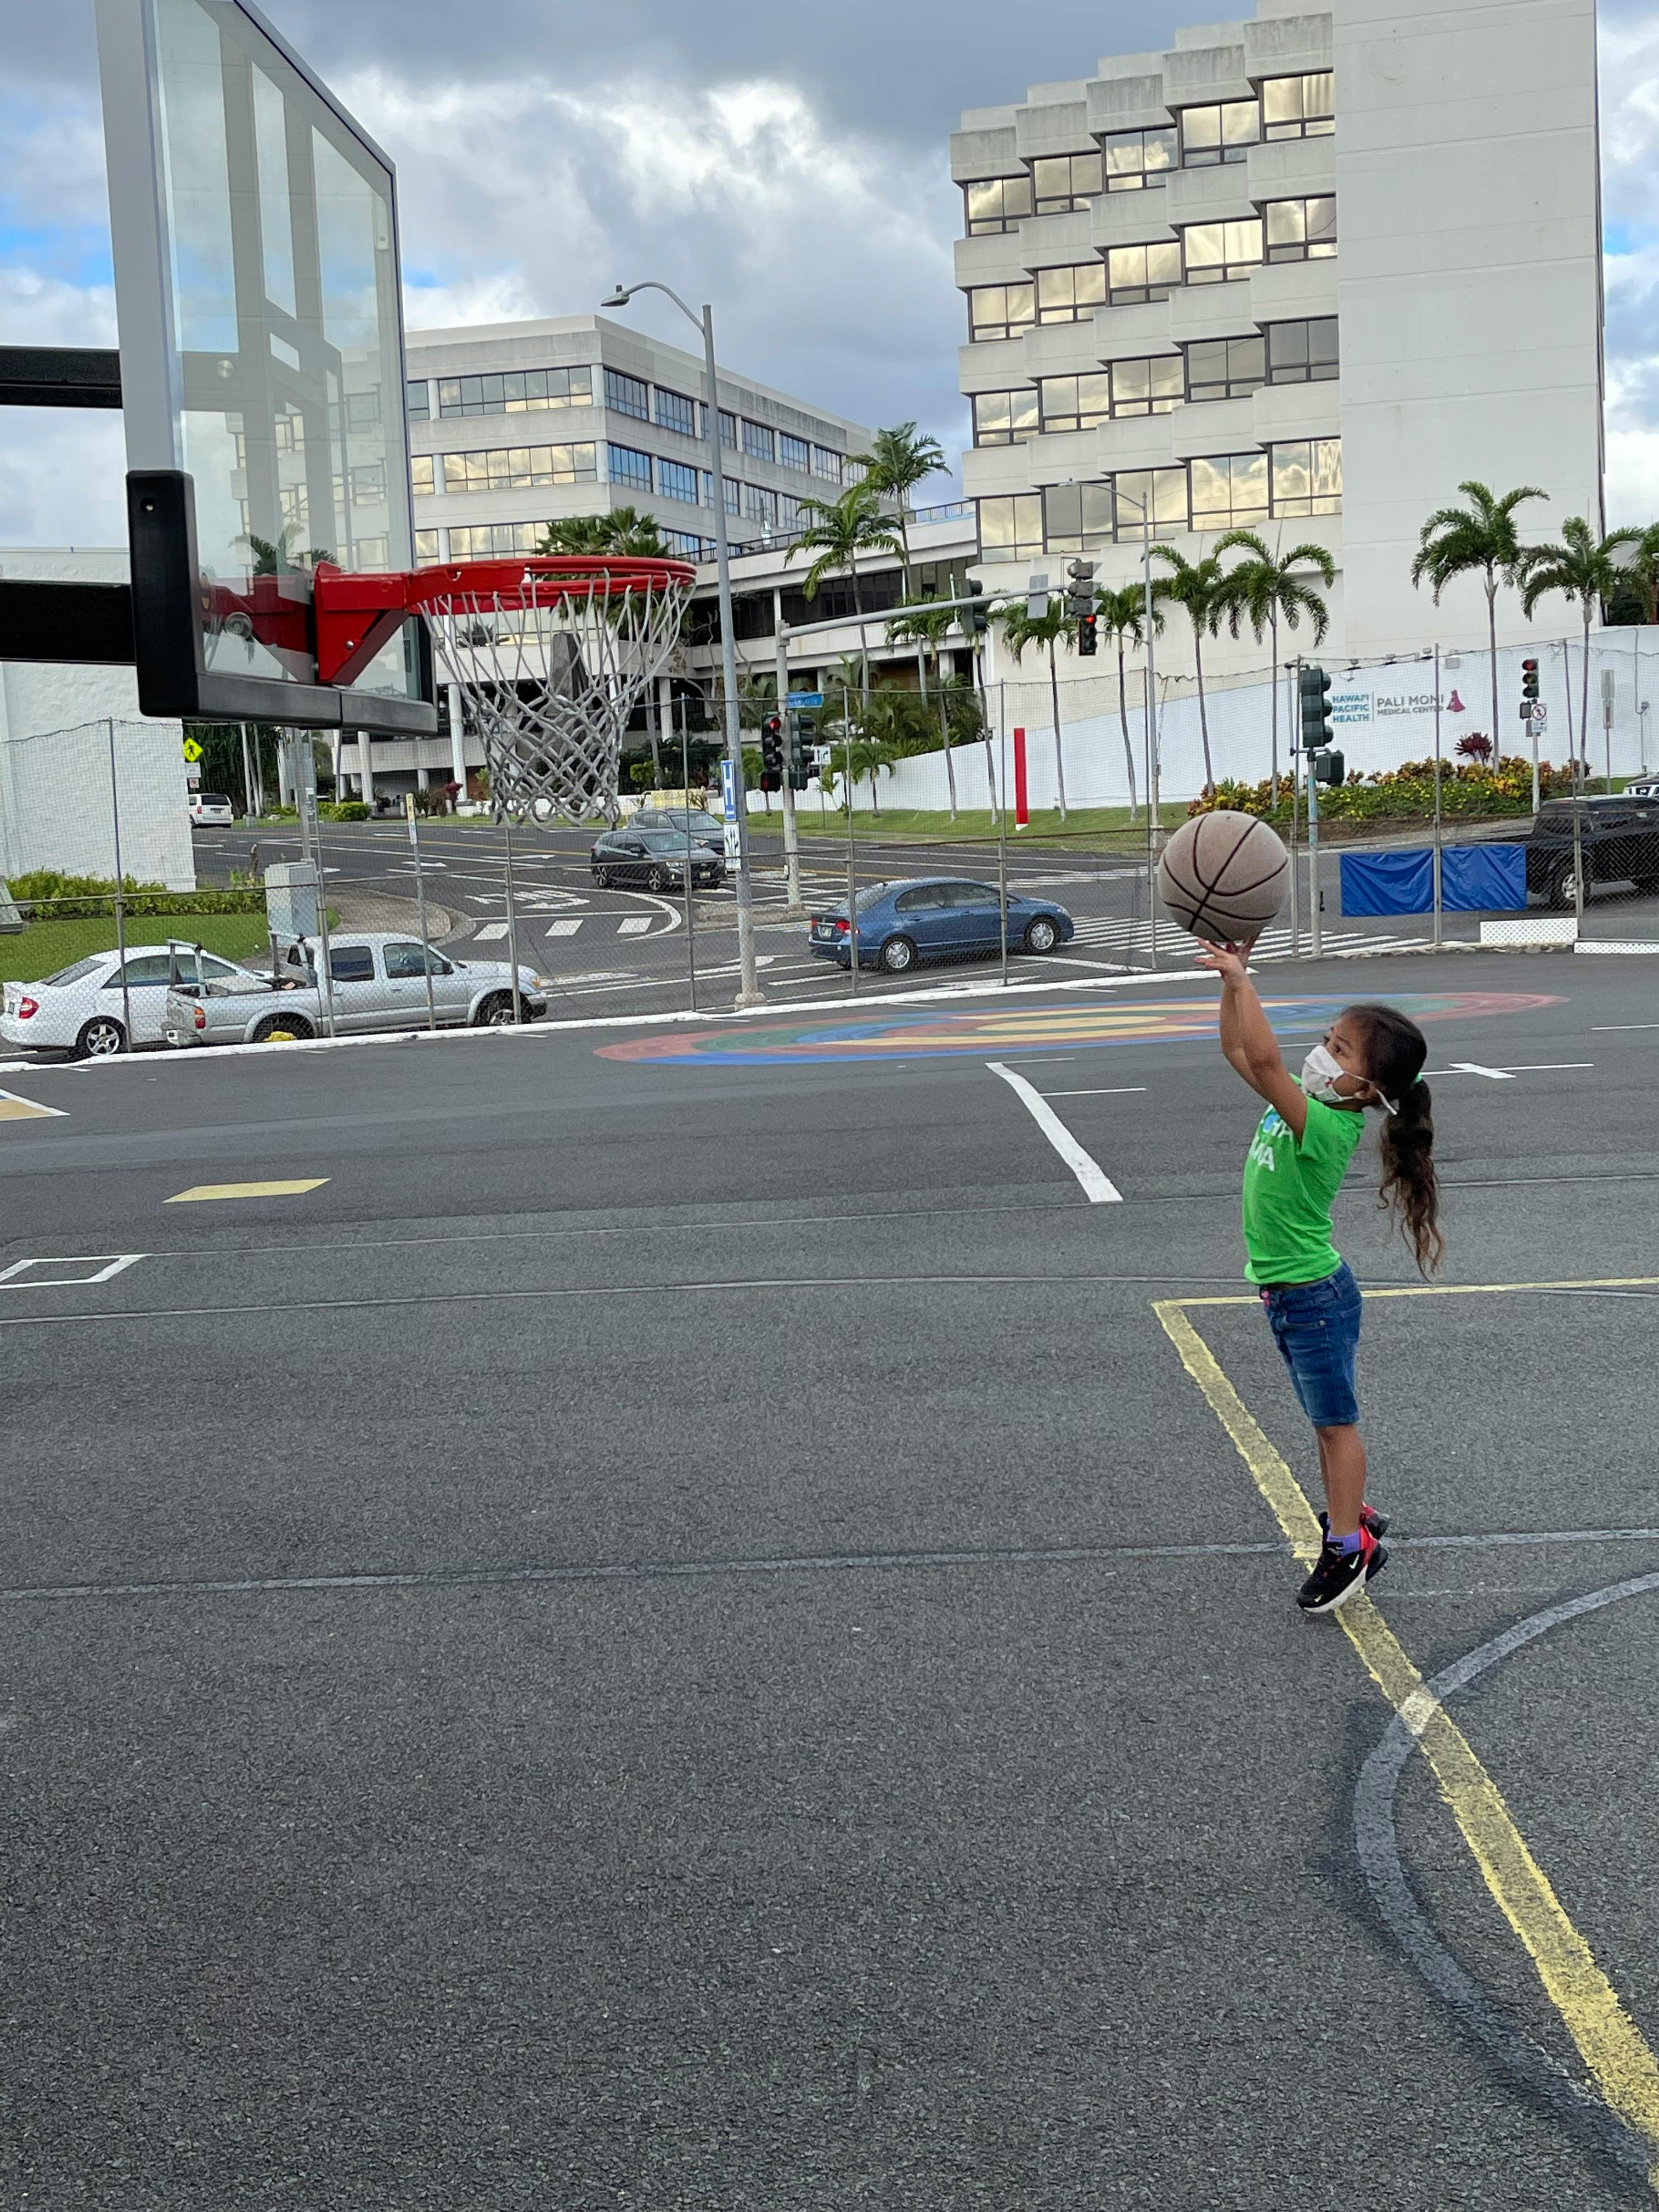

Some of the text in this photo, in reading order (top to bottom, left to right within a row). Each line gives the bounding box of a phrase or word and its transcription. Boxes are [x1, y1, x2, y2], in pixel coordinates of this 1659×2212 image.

[1377, 697, 1404, 707] PALI
[1332, 704, 1369, 713] PACIFIC
[1377, 707, 1411, 715] MEDICAL
[1333, 714, 1369, 723] HEALTH
[723, 764, 735, 806] H
